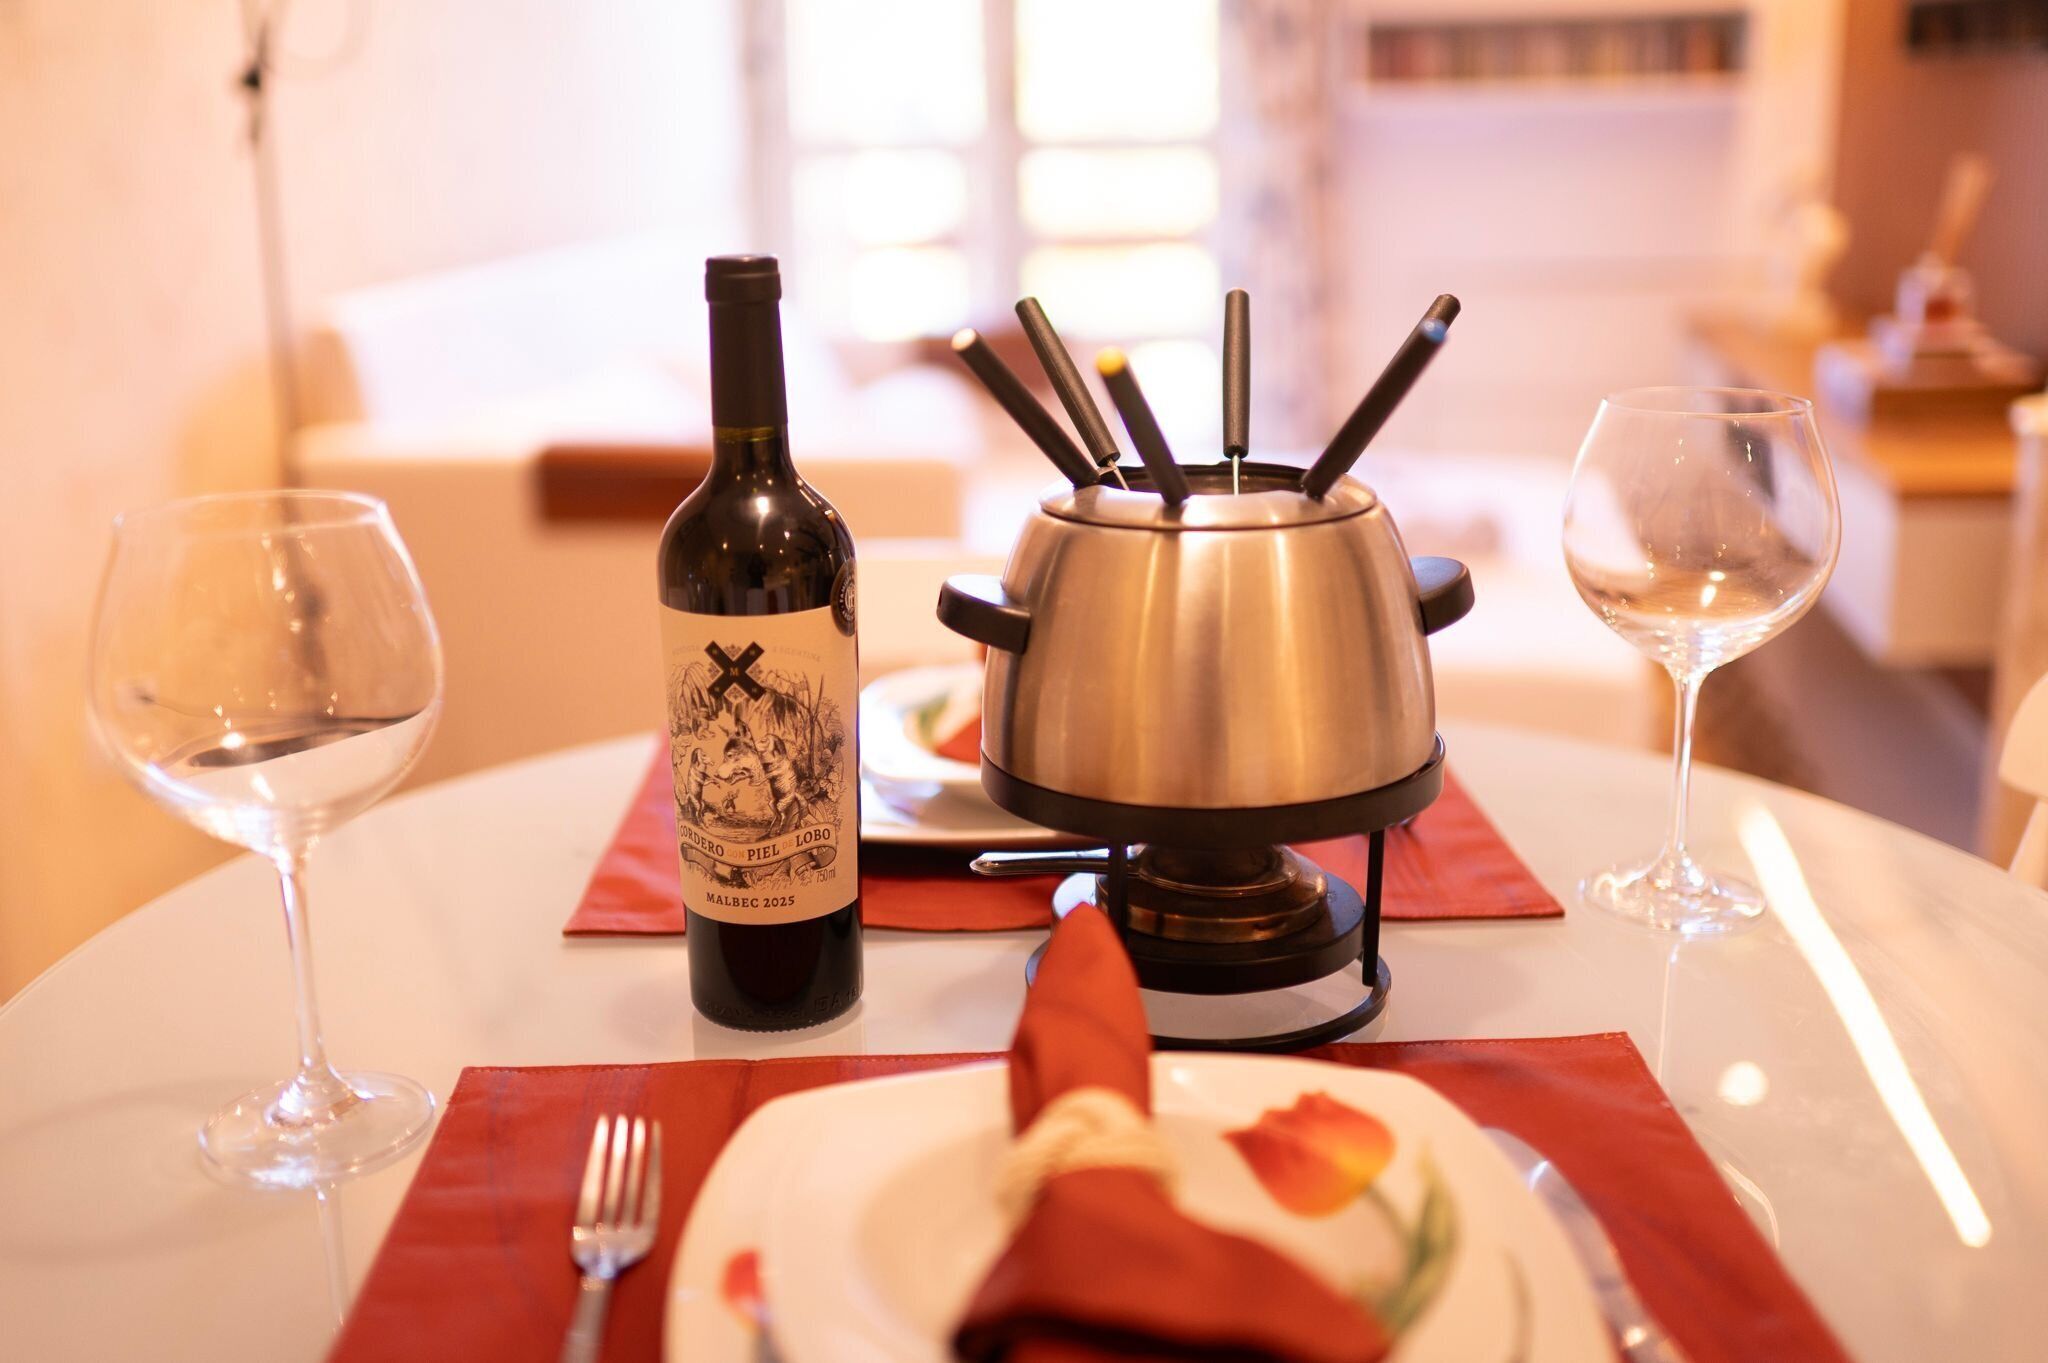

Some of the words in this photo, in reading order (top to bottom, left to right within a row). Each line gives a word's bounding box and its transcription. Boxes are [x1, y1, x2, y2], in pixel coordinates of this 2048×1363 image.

[679, 824, 725, 857] CORDERO
[747, 844, 780, 861] PIEL
[782, 839, 794, 850] DE
[795, 828, 831, 848] LOBO
[706, 892, 759, 908] MALBEC
[764, 895, 795, 908] 2025
